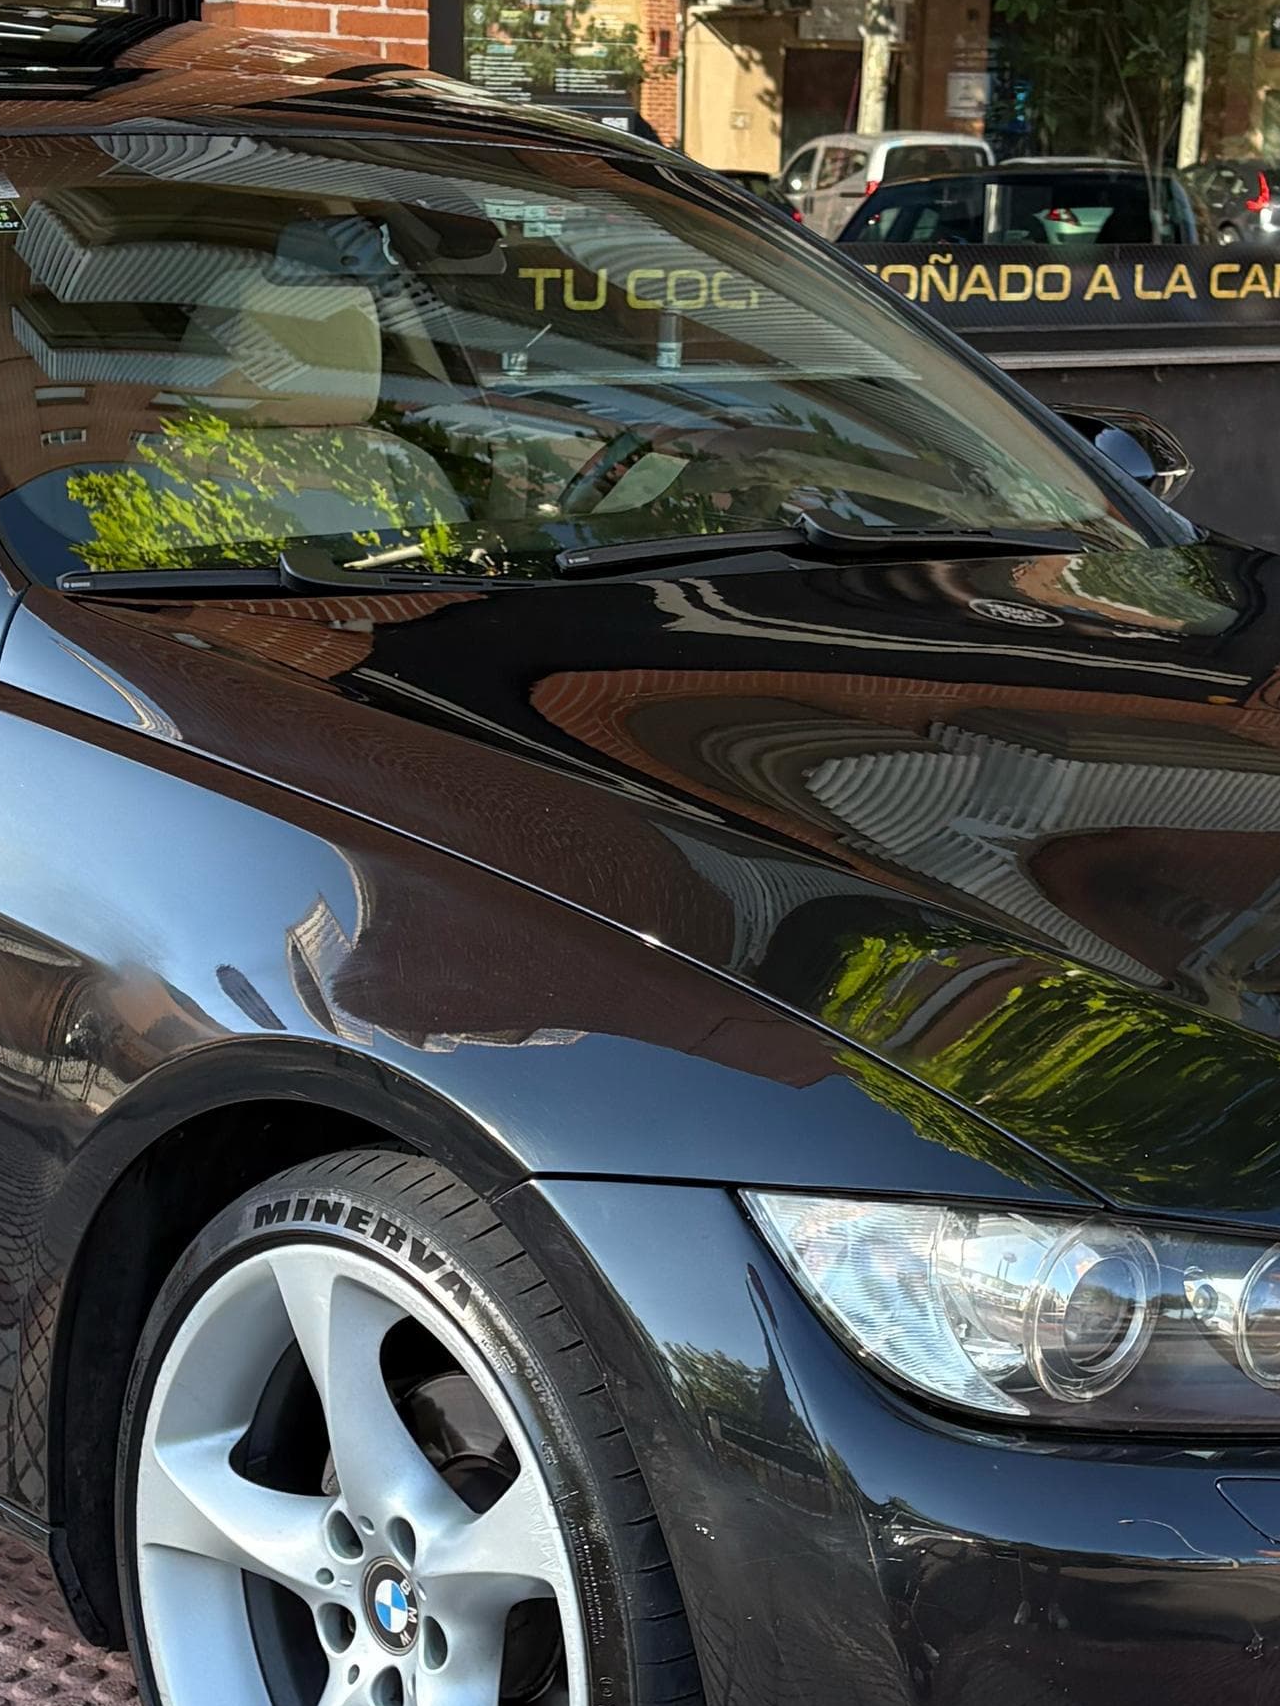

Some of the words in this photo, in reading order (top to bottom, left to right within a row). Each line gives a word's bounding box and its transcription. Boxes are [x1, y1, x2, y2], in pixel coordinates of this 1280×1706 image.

[518, 268, 607, 310] TU
[627, 269, 761, 310] COC
[863, 253, 1073, 302] OÑADO
[1084, 264, 1121, 301] A
[1134, 264, 1197, 300] LA
[253, 1198, 472, 1311] MINERVA
